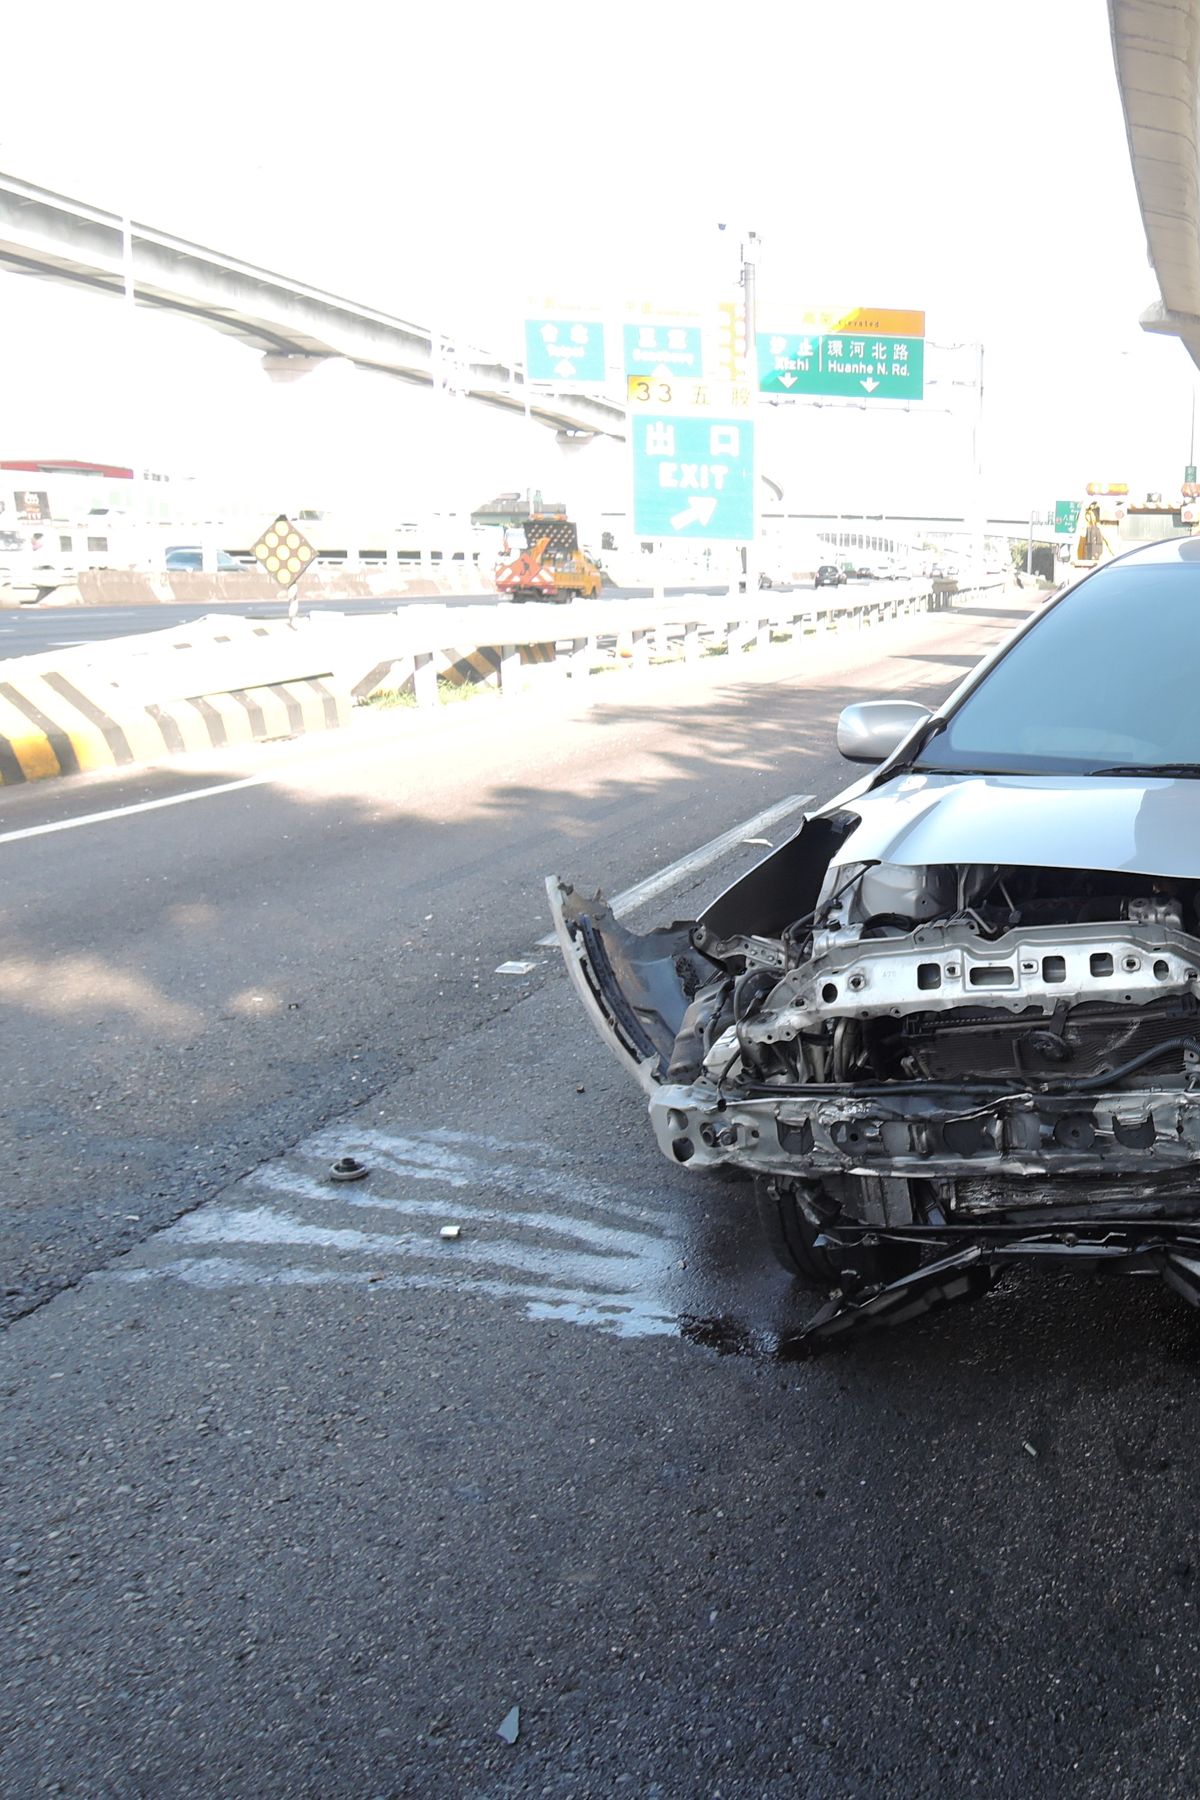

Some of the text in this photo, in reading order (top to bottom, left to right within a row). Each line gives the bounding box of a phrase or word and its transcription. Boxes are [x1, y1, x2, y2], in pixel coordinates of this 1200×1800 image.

[827, 340, 909, 361] 環河北路
[827, 360, 910, 377] Huanhe N. Rd.
[636, 381, 673, 403] 33
[646, 420, 740, 457] 出口
[659, 461, 729, 490] EXIT
